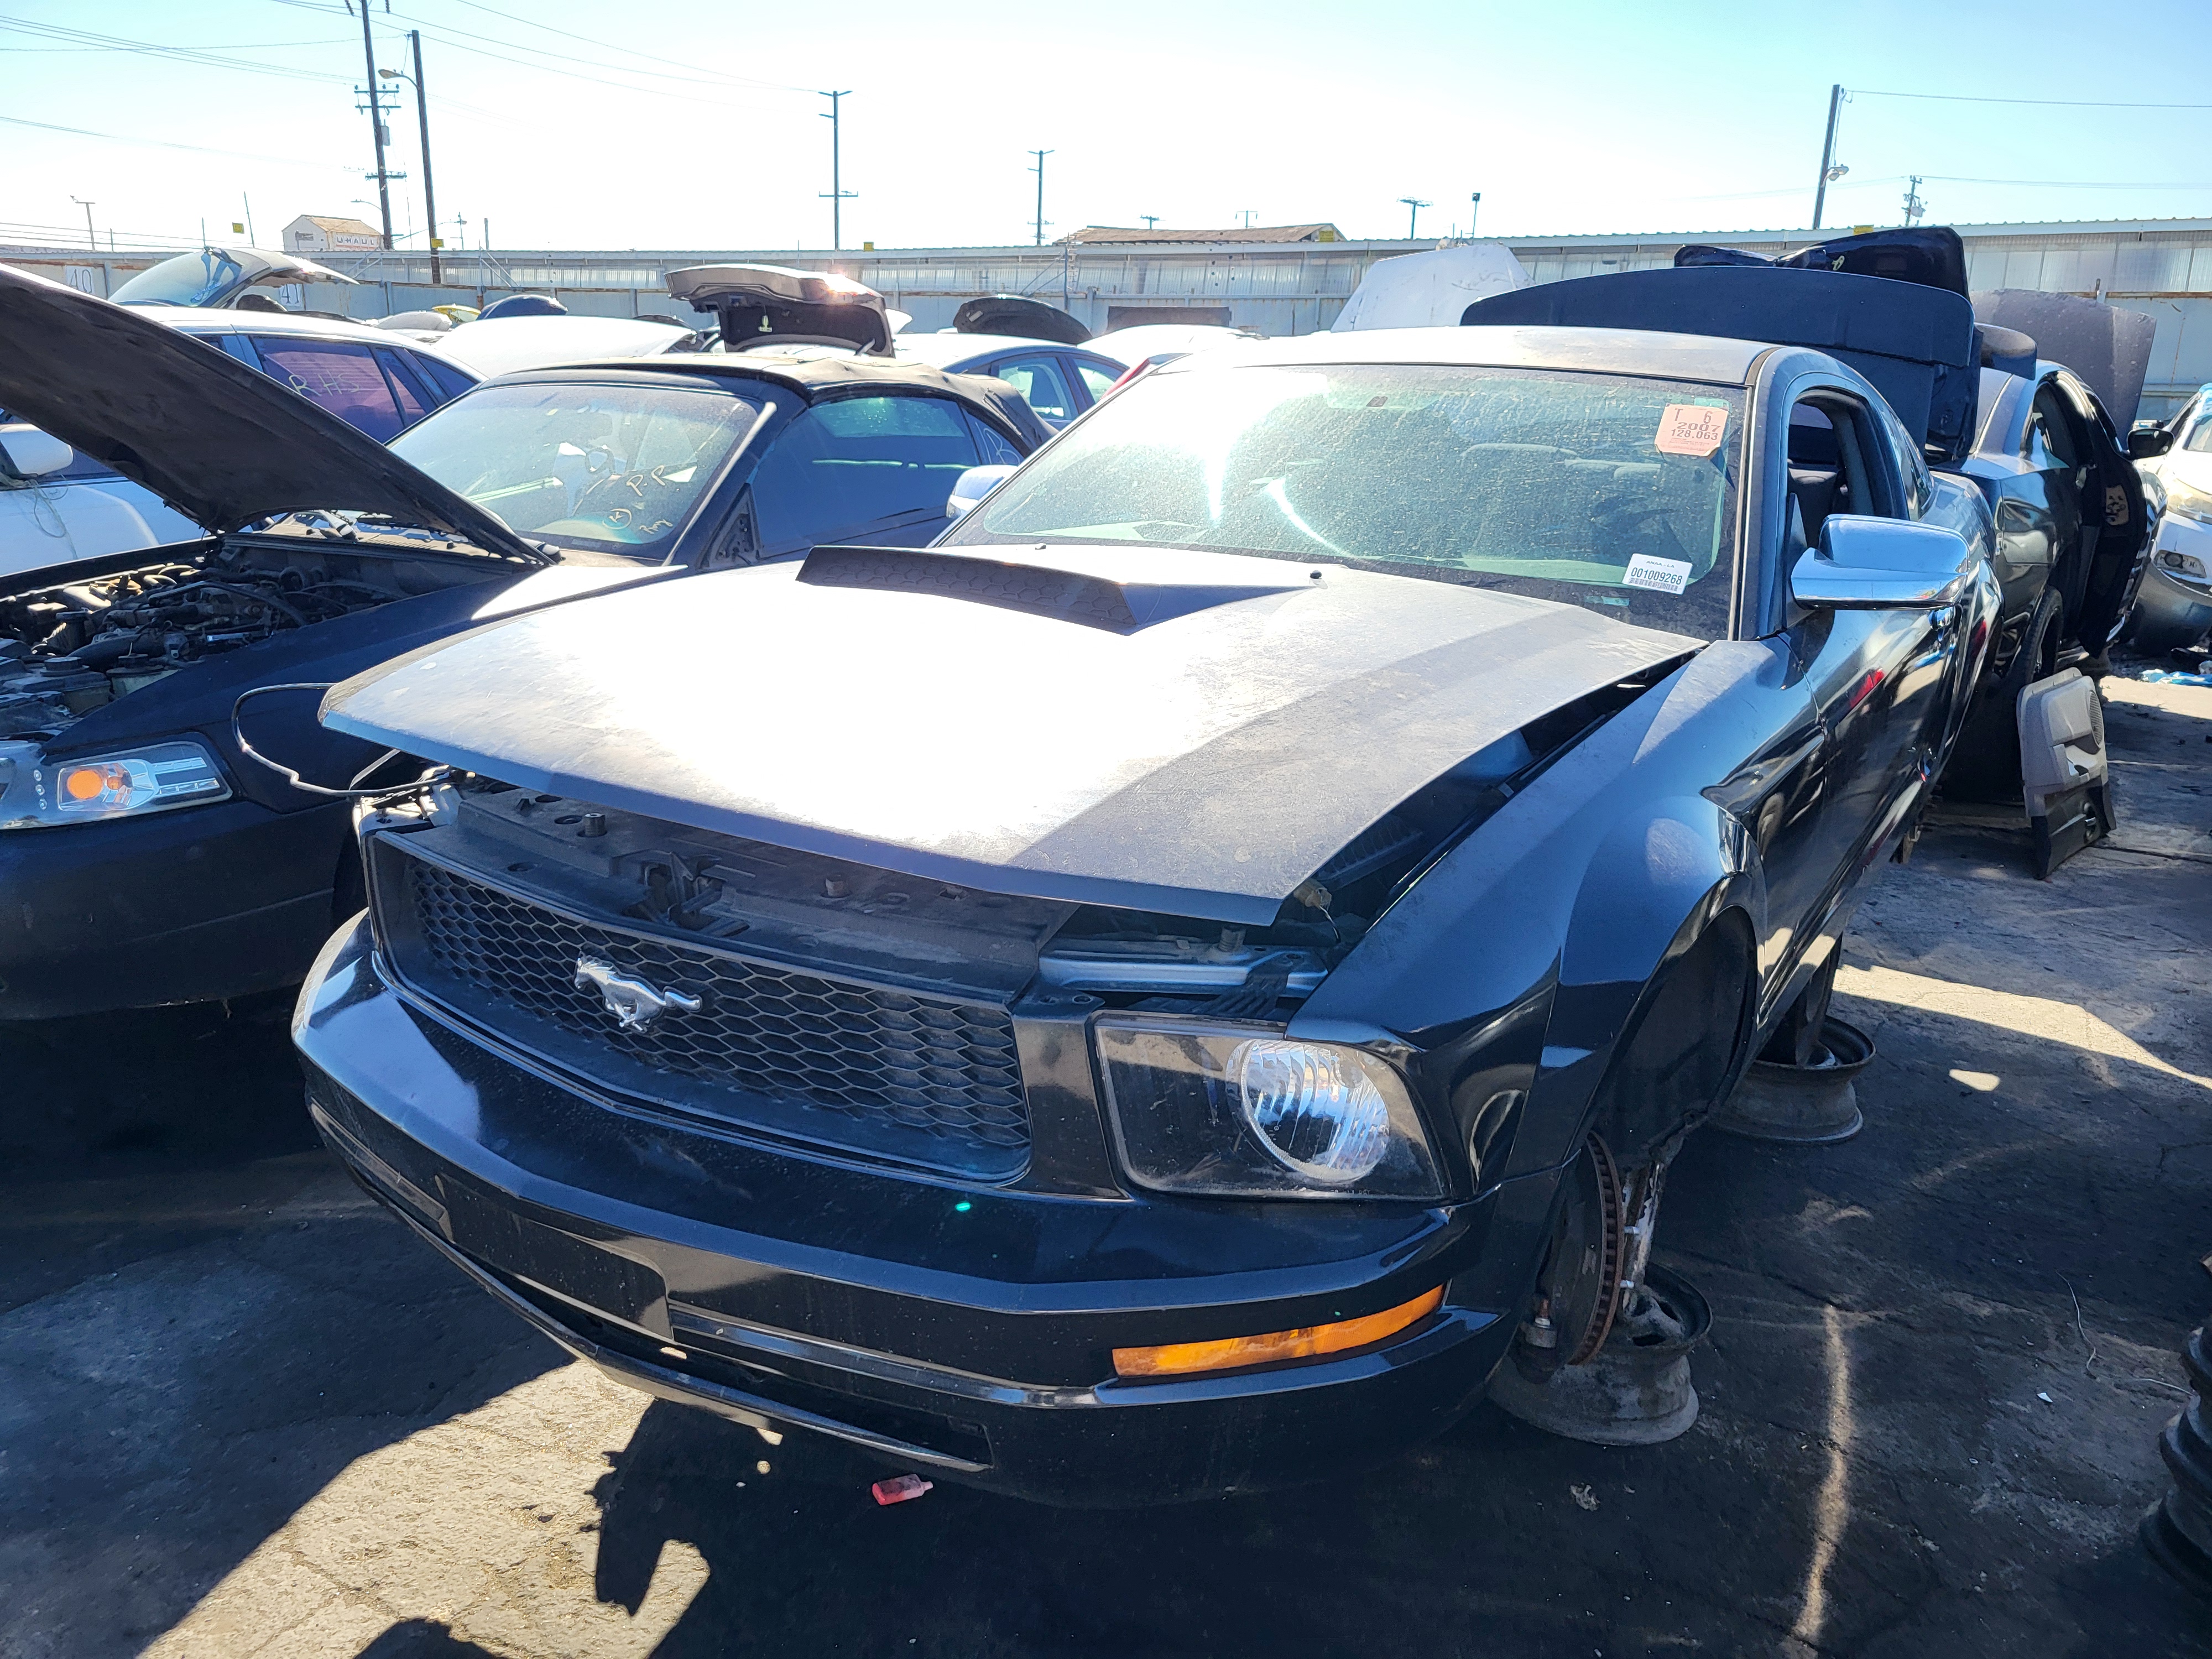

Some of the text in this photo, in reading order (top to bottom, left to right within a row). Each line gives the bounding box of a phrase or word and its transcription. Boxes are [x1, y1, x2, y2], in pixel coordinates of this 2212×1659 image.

[69, 269, 92, 293] 40
[281, 284, 300, 304] 41
[1674, 408, 1713, 424] T 6
[1676, 422, 1721, 432] 2007
[1631, 567, 1683, 585] 001009268
